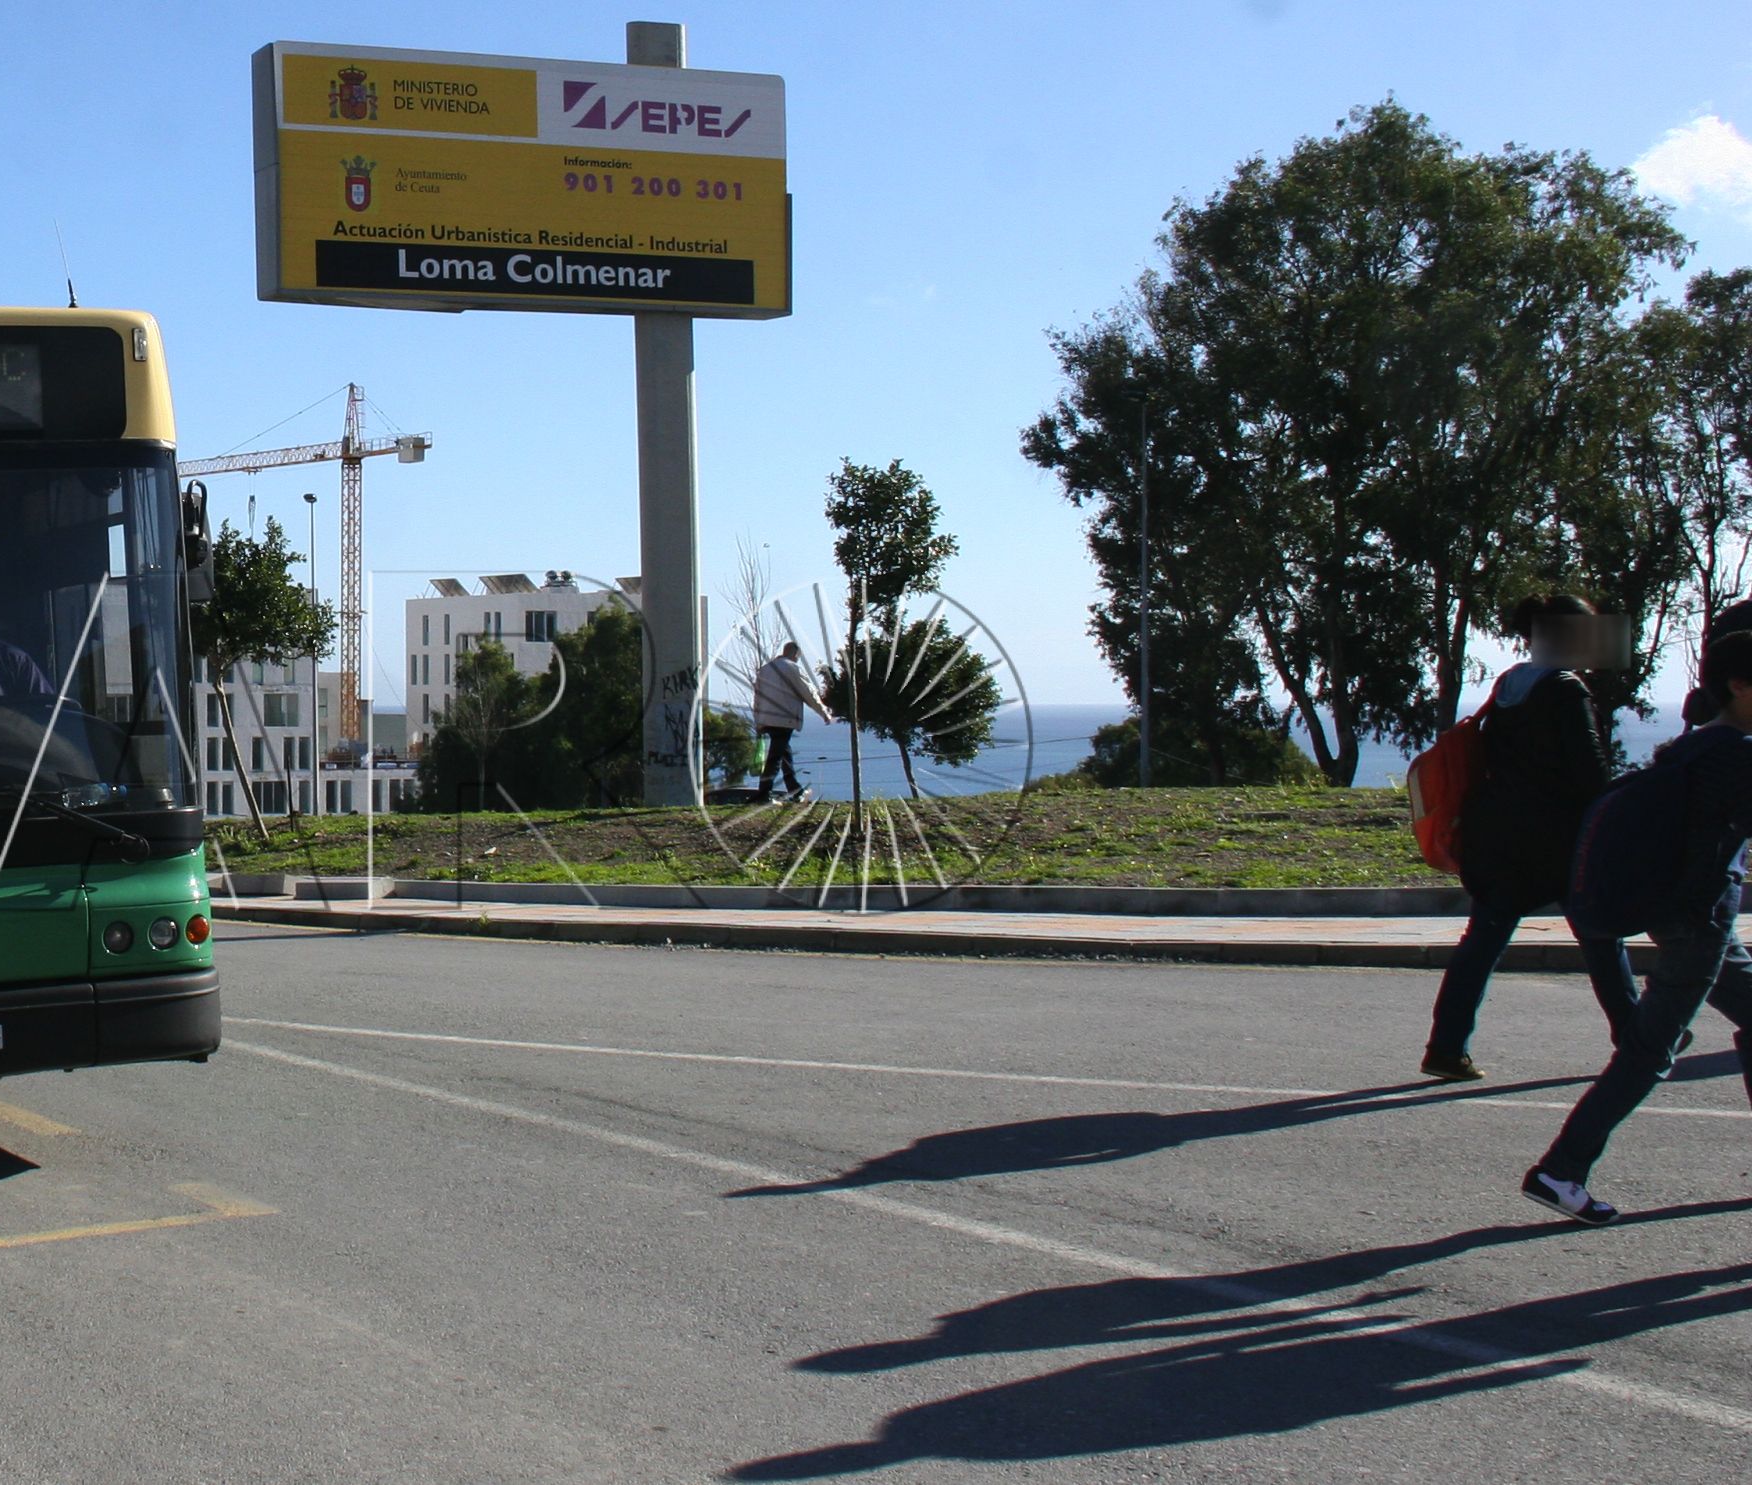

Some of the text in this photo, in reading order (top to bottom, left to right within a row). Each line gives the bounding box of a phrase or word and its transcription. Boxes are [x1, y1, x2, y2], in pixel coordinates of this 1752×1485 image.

[393, 79, 478, 97] MINISTERIO
[394, 96, 490, 115] DE VIVIENDA
[563, 155, 633, 170] Información:
[395, 167, 467, 181] Ayuntamiento
[395, 181, 440, 193] de Ceuta
[564, 172, 743, 201] 901 200 301
[333, 220, 425, 240] Actuación
[538, 229, 633, 250] Residencial
[649, 235, 728, 254] Industrial
[398, 248, 671, 289] Loma Colmenar
